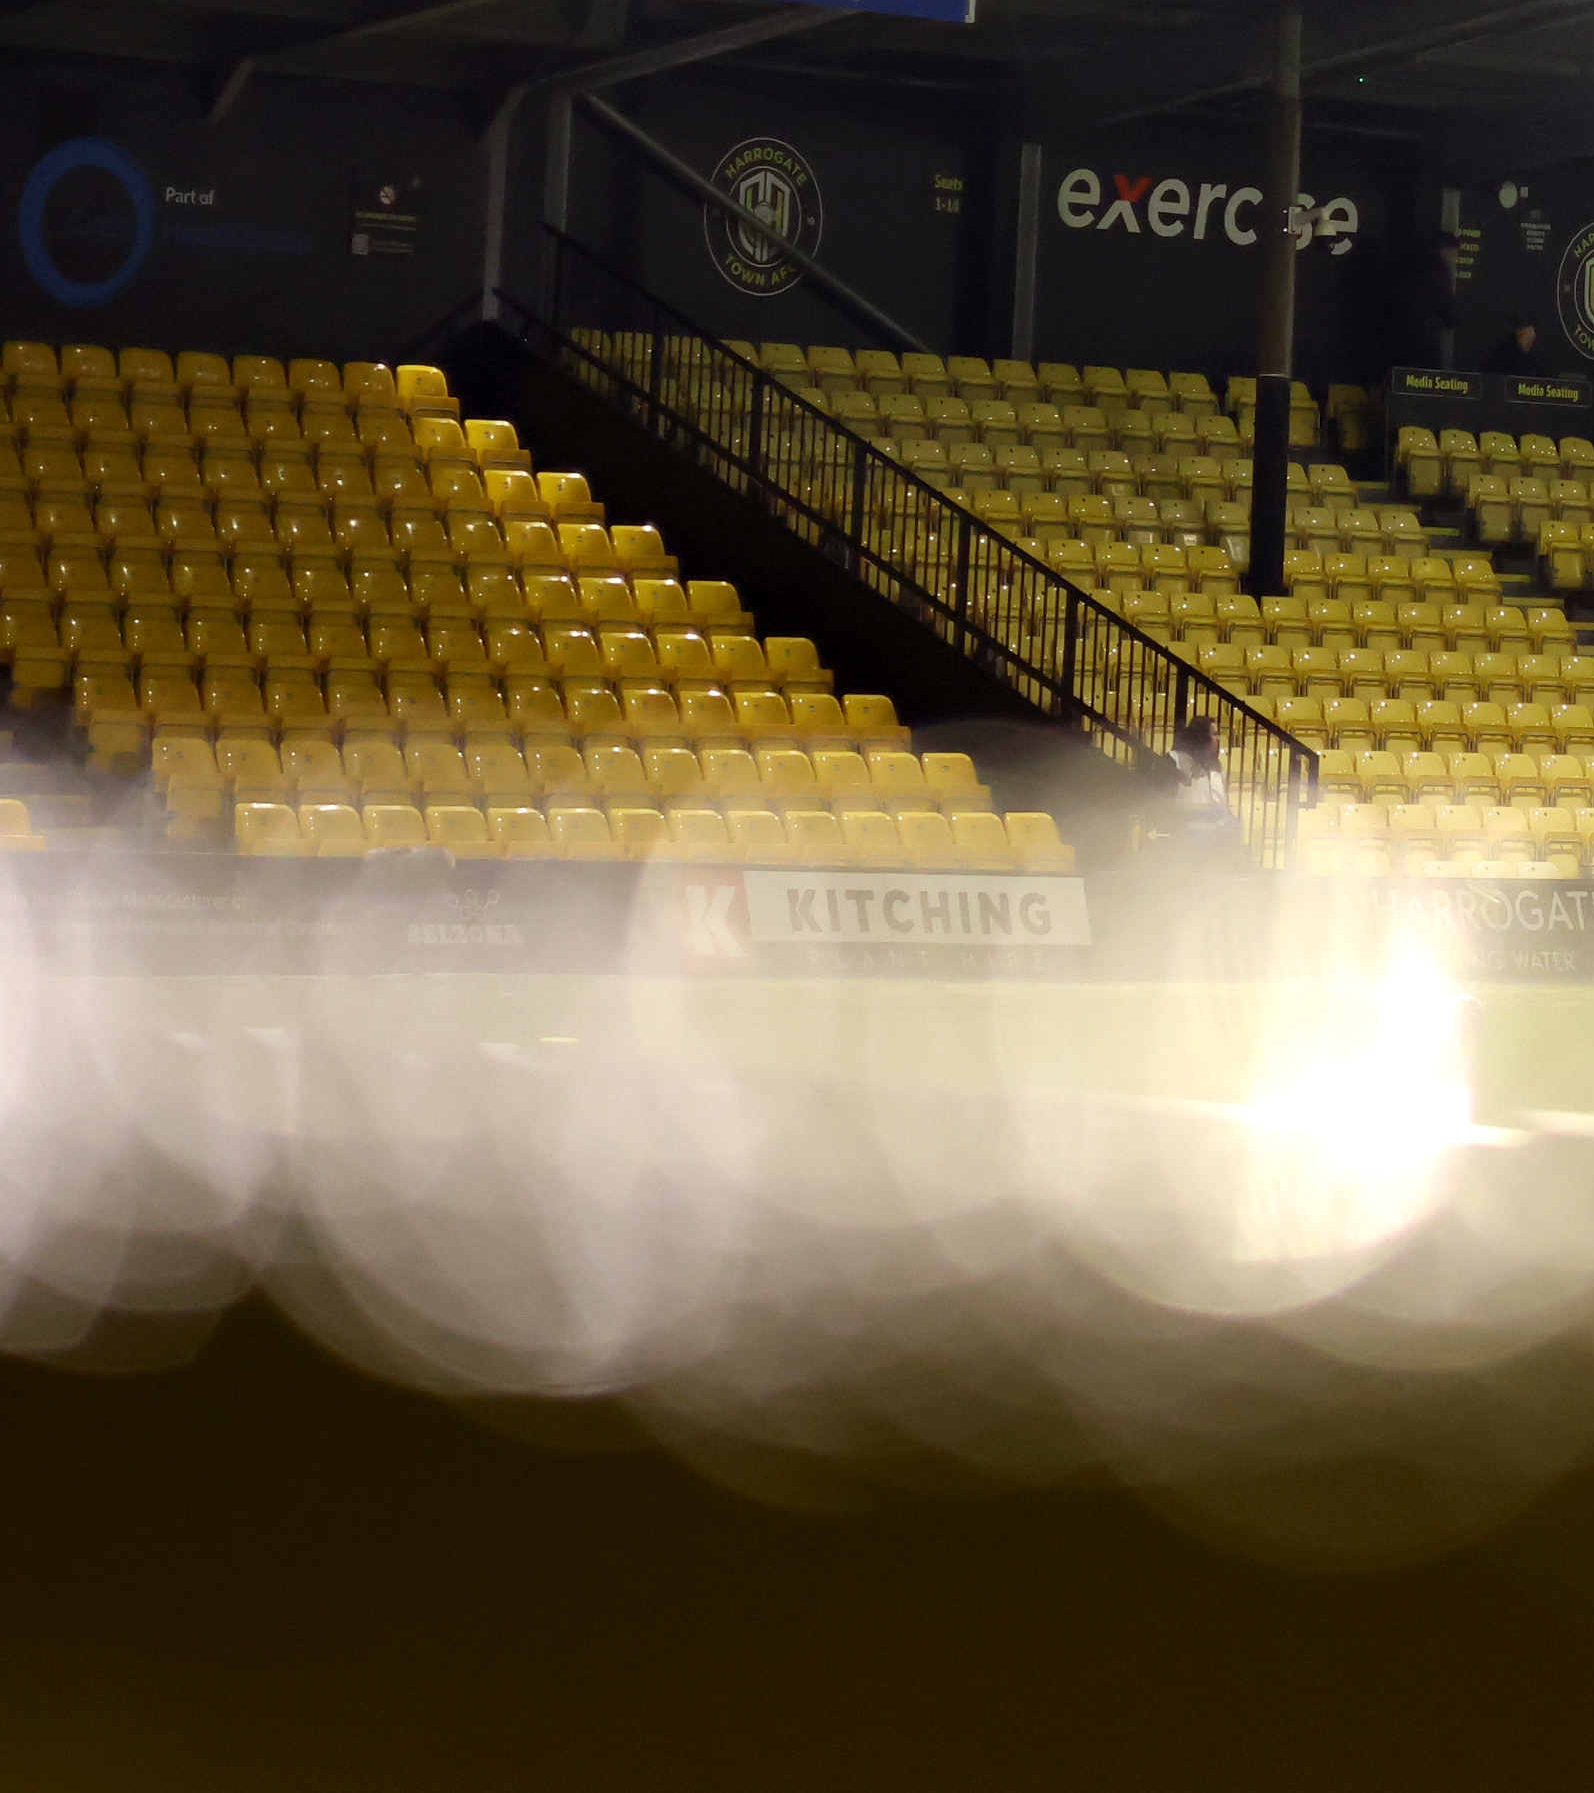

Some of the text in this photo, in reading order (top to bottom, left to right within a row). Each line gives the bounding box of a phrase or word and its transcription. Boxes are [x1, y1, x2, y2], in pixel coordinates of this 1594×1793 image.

[724, 147, 808, 187] HARROGATE
[165, 186, 216, 206] Part of
[1057, 168, 1359, 255] exerce
[725, 254, 767, 286] TOWN
[1405, 374, 1469, 395] Media Seating
[1517, 383, 1579, 402] Media Seating
[786, 888, 1053, 936] KITCHING
[1511, 951, 1577, 972] WATER
